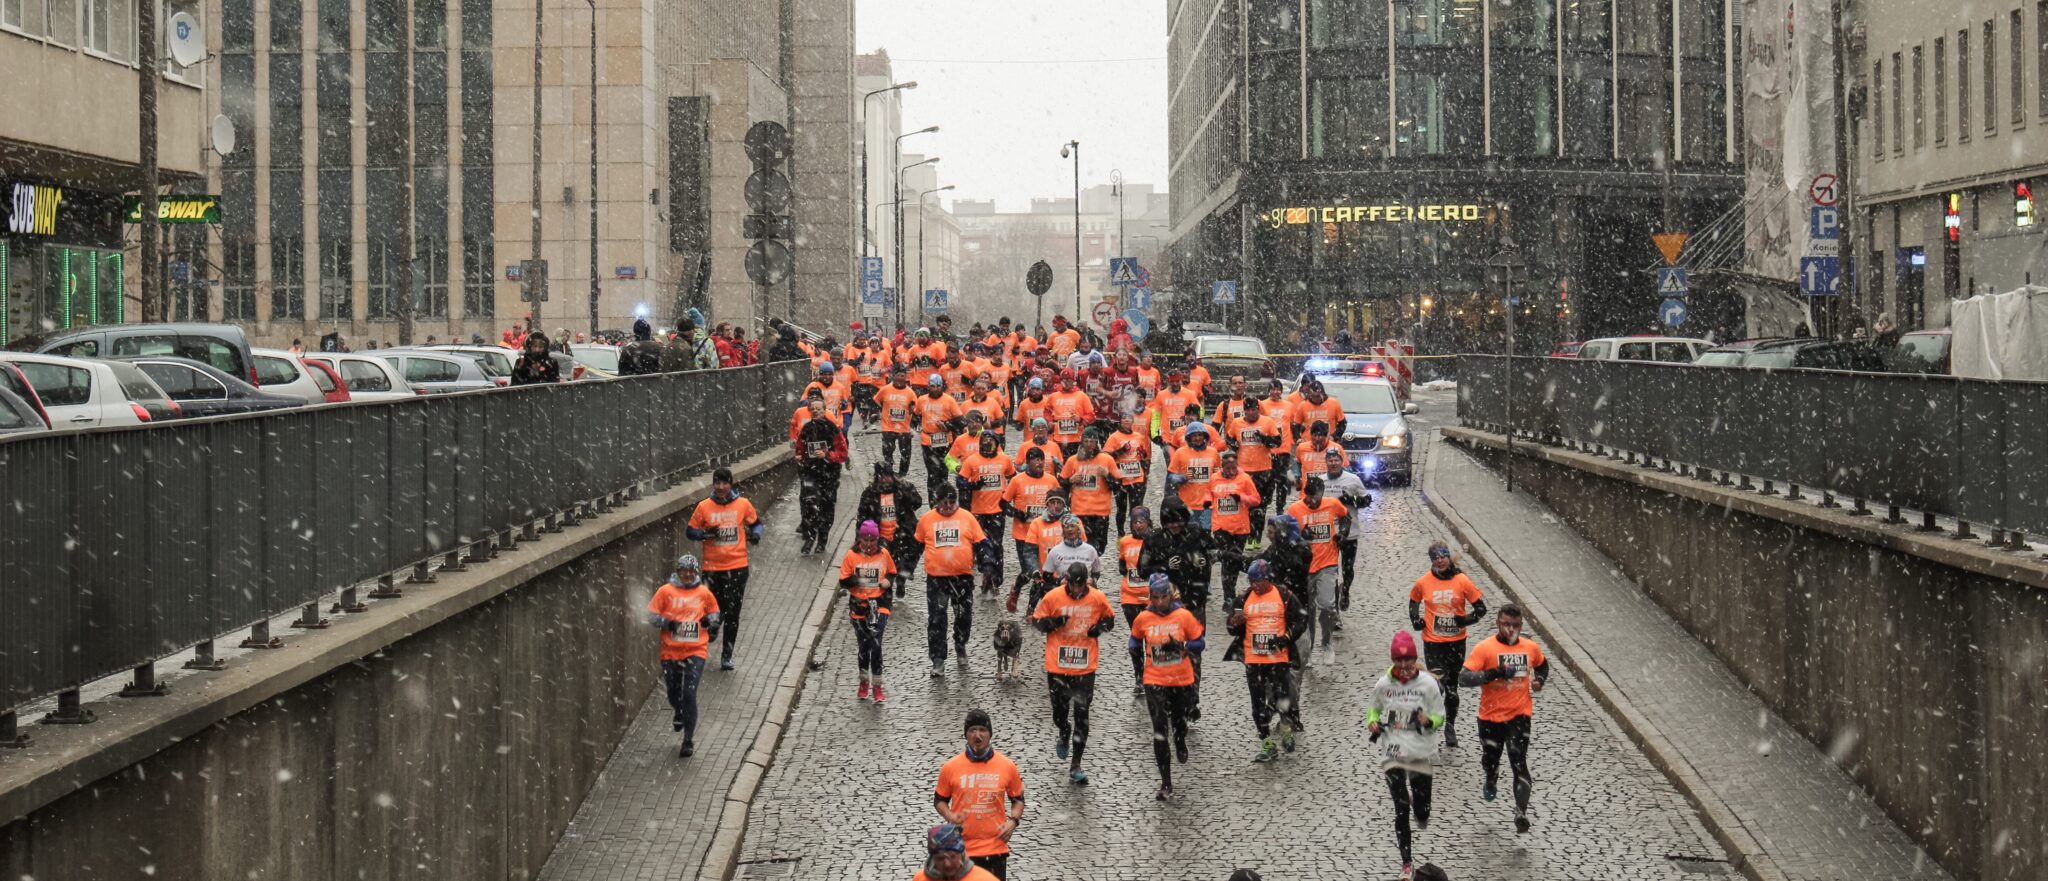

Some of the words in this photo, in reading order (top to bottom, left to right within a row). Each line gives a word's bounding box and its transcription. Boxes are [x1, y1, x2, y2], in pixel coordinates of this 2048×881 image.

[9, 182, 62, 235] SUBWAY
[130, 200, 215, 219] SBWAY
[1271, 206, 1317, 229] green
[1819, 210, 1838, 234] P
[867, 259, 880, 276] P
[867, 280, 879, 297] P
[938, 530, 956, 538] 2501
[1503, 655, 1524, 665] 2267
[960, 773, 976, 789] 11
